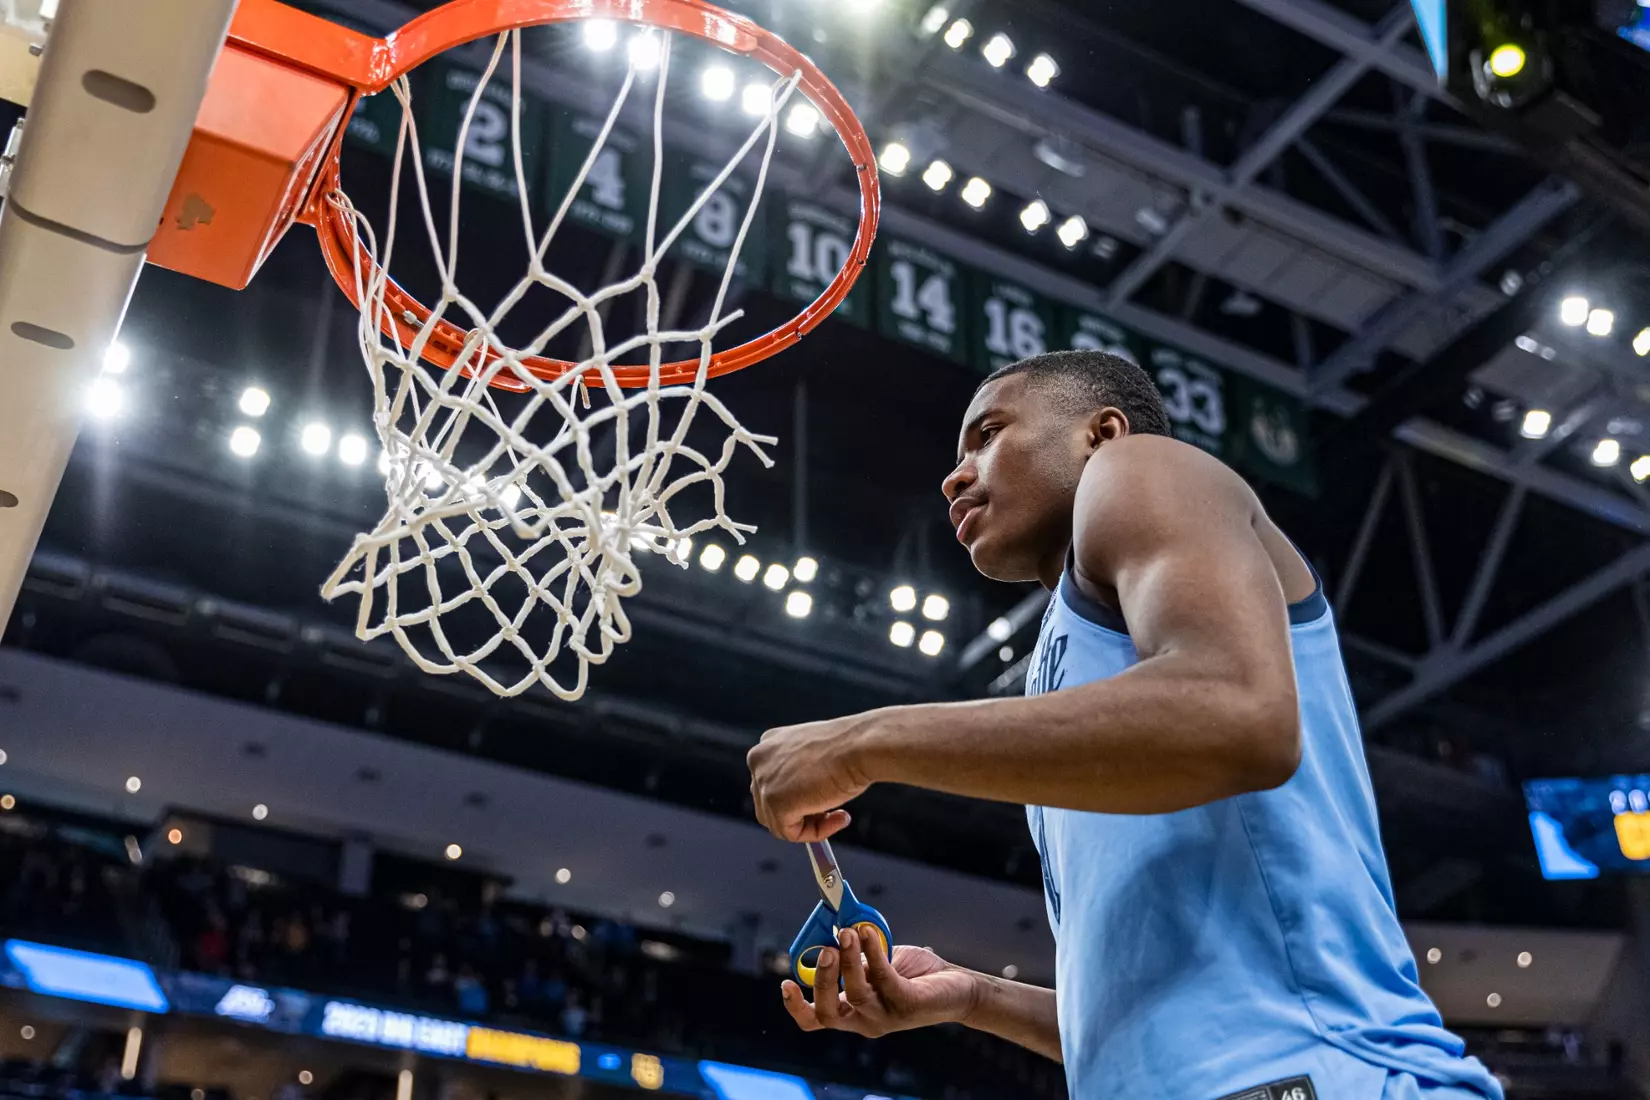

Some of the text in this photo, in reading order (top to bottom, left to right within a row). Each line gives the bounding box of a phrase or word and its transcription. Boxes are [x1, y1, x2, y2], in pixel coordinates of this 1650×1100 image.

[459, 99, 507, 167] 2
[584, 146, 626, 211] 4
[694, 188, 737, 248] 8
[787, 221, 850, 287] 10
[890, 260, 956, 333] 14
[984, 297, 1046, 359] 16
[1157, 367, 1225, 434] 33
